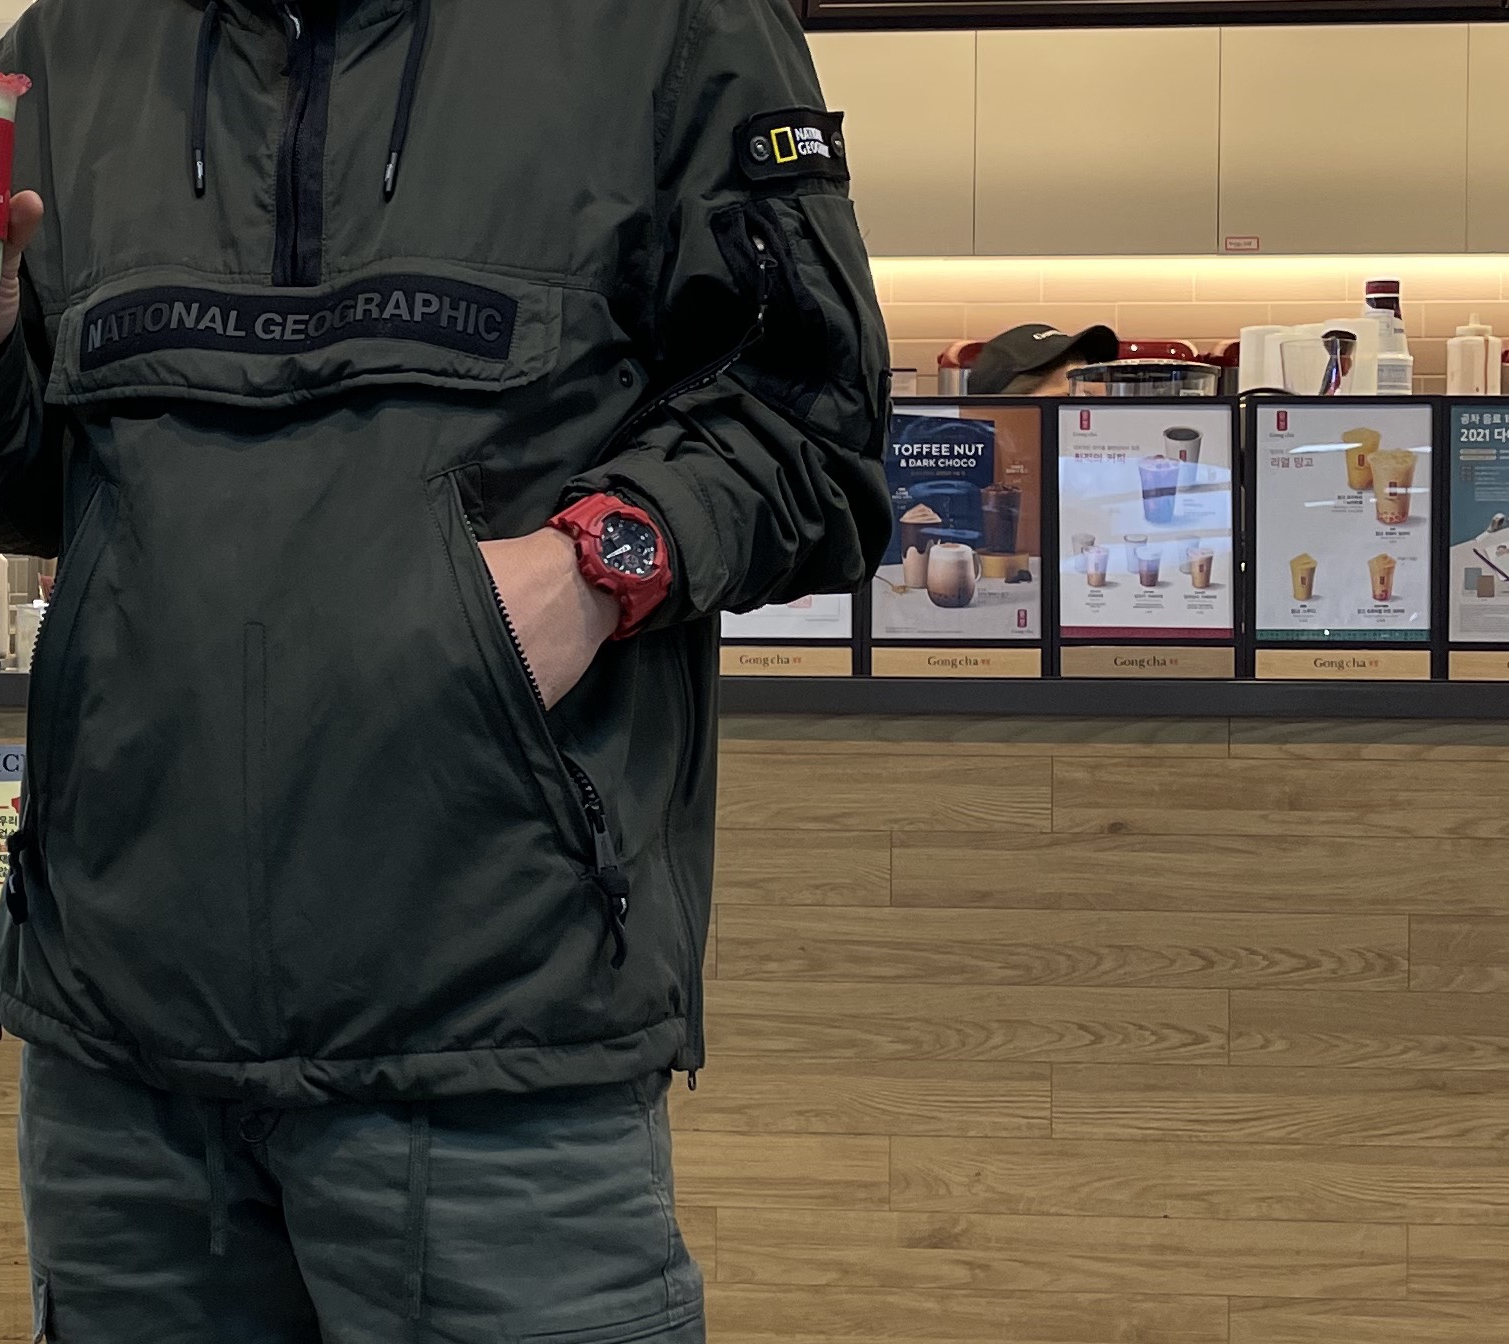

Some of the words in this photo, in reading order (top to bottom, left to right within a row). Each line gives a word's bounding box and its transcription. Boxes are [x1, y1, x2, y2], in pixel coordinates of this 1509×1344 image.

[87, 301, 246, 353] NATIONAL
[254, 289, 503, 342] GEOGRAPHIC
[1460, 429, 1490, 442] 2021
[892, 444, 950, 456] TOFFEE
[953, 444, 984, 456] NUT
[900, 459, 907, 467] &
[909, 459, 936, 467] DARK
[938, 459, 976, 467] CHOCO
[1271, 457, 1290, 468] 리얼
[1294, 457, 1314, 468] 망고
[740, 655, 769, 667] Gong
[771, 654, 790, 665] cha
[927, 656, 957, 668] Gong
[959, 655, 979, 666] cha
[1114, 656, 1145, 669] Gong
[1146, 655, 1166, 666] cha
[1314, 657, 1345, 670] Gong
[1346, 657, 1366, 668] cha
